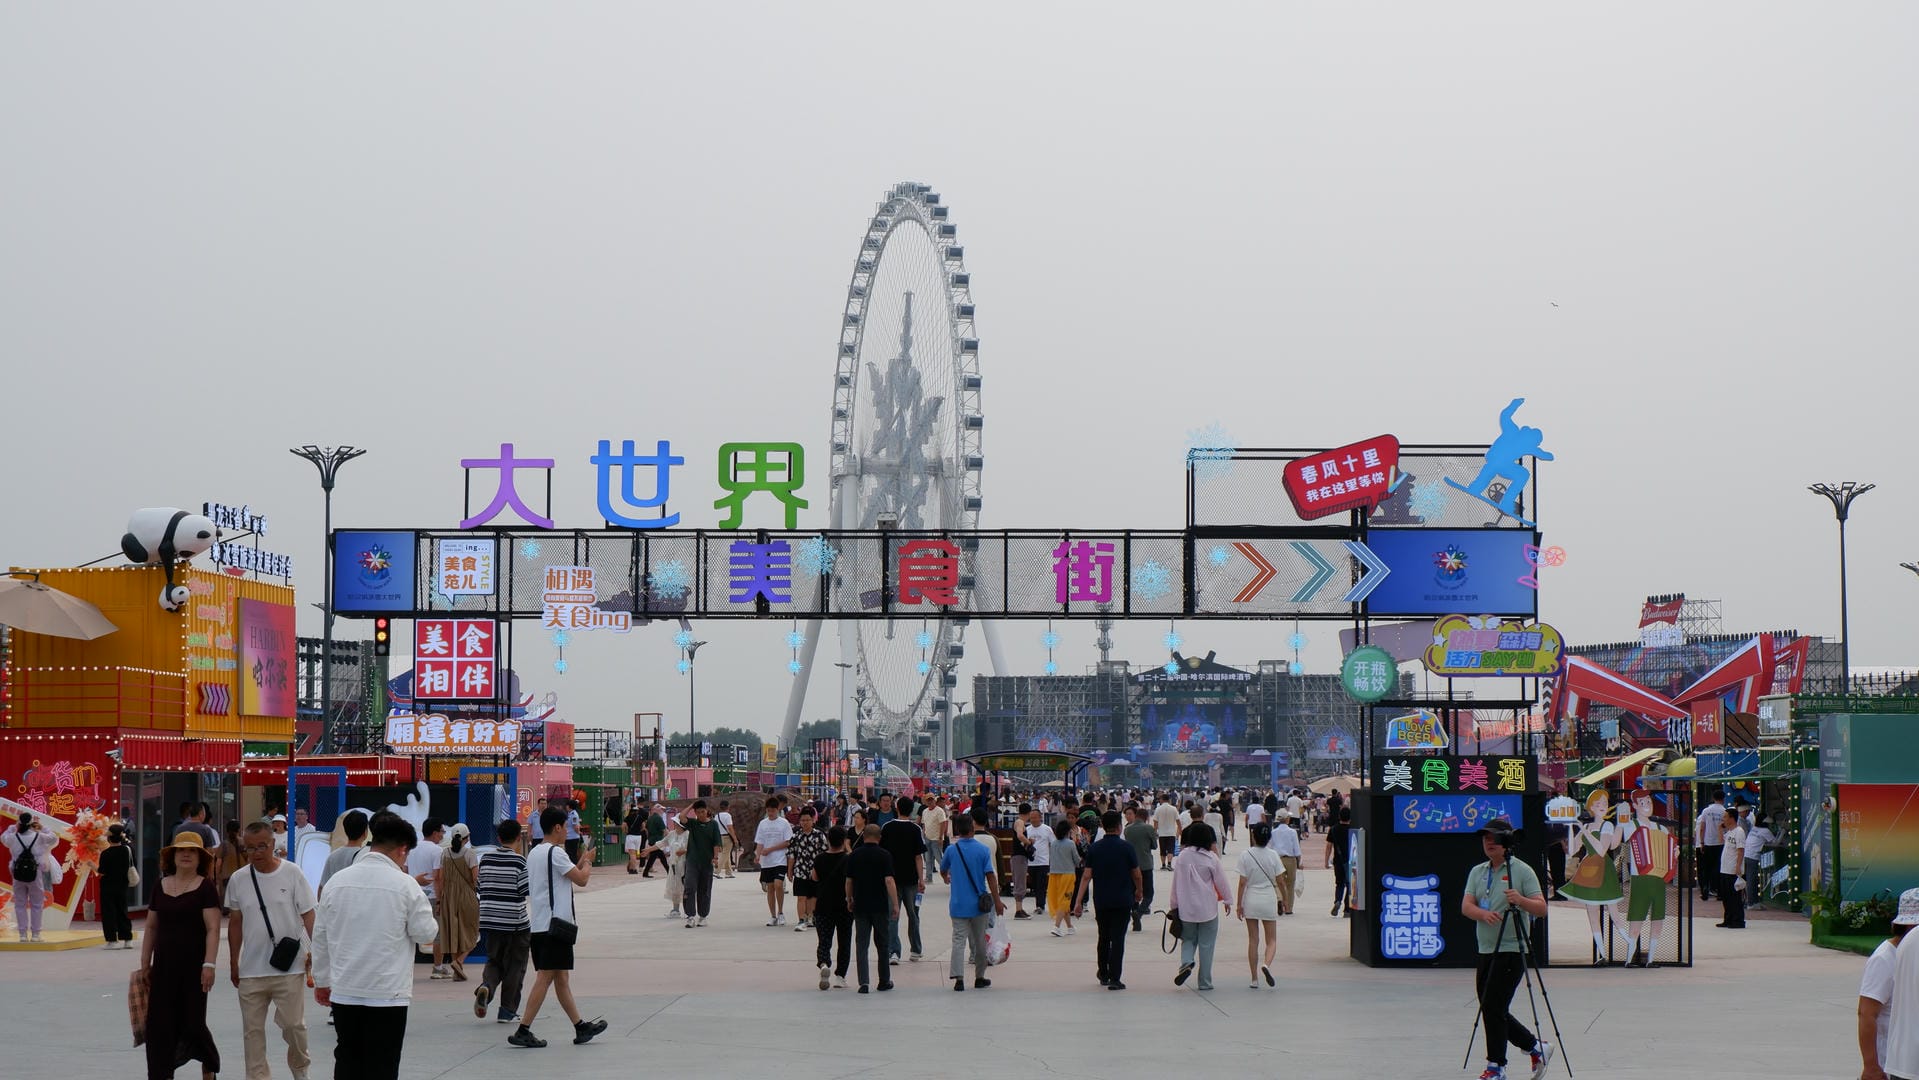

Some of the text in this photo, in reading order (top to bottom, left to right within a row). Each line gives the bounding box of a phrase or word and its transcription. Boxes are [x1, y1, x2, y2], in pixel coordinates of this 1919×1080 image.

[1301, 448, 1381, 484] 春风十里
[460, 440, 809, 529] 大世界
[1306, 472, 1386, 502] 我在这里等你
[444, 556, 477, 571] 美食
[481, 555, 490, 589] STYLE
[729, 540, 1115, 605] 美食街
[444, 574, 477, 590] 范儿
[545, 568, 593, 591] 相遇
[545, 605, 630, 631] 美食ing
[1642, 607, 1678, 620] Budweiser
[250, 626, 286, 652] HARBIN
[419, 623, 490, 656] 美食
[252, 656, 287, 690] 哈尔滨
[1354, 661, 1387, 676] 开瓶
[1444, 651, 1481, 667] 活力
[419, 664, 490, 694] 相伴
[1354, 676, 1387, 692] 畅饮
[1397, 731, 1431, 743] BEER
[1404, 722, 1432, 733] LOVE
[394, 745, 509, 753] WELCOME TO CHENGXIANG
[28, 761, 96, 795] 吃货们
[1383, 759, 1526, 792] 美食美酒
[1385, 893, 1438, 923] 起来
[1385, 926, 1441, 956] 哈酒
